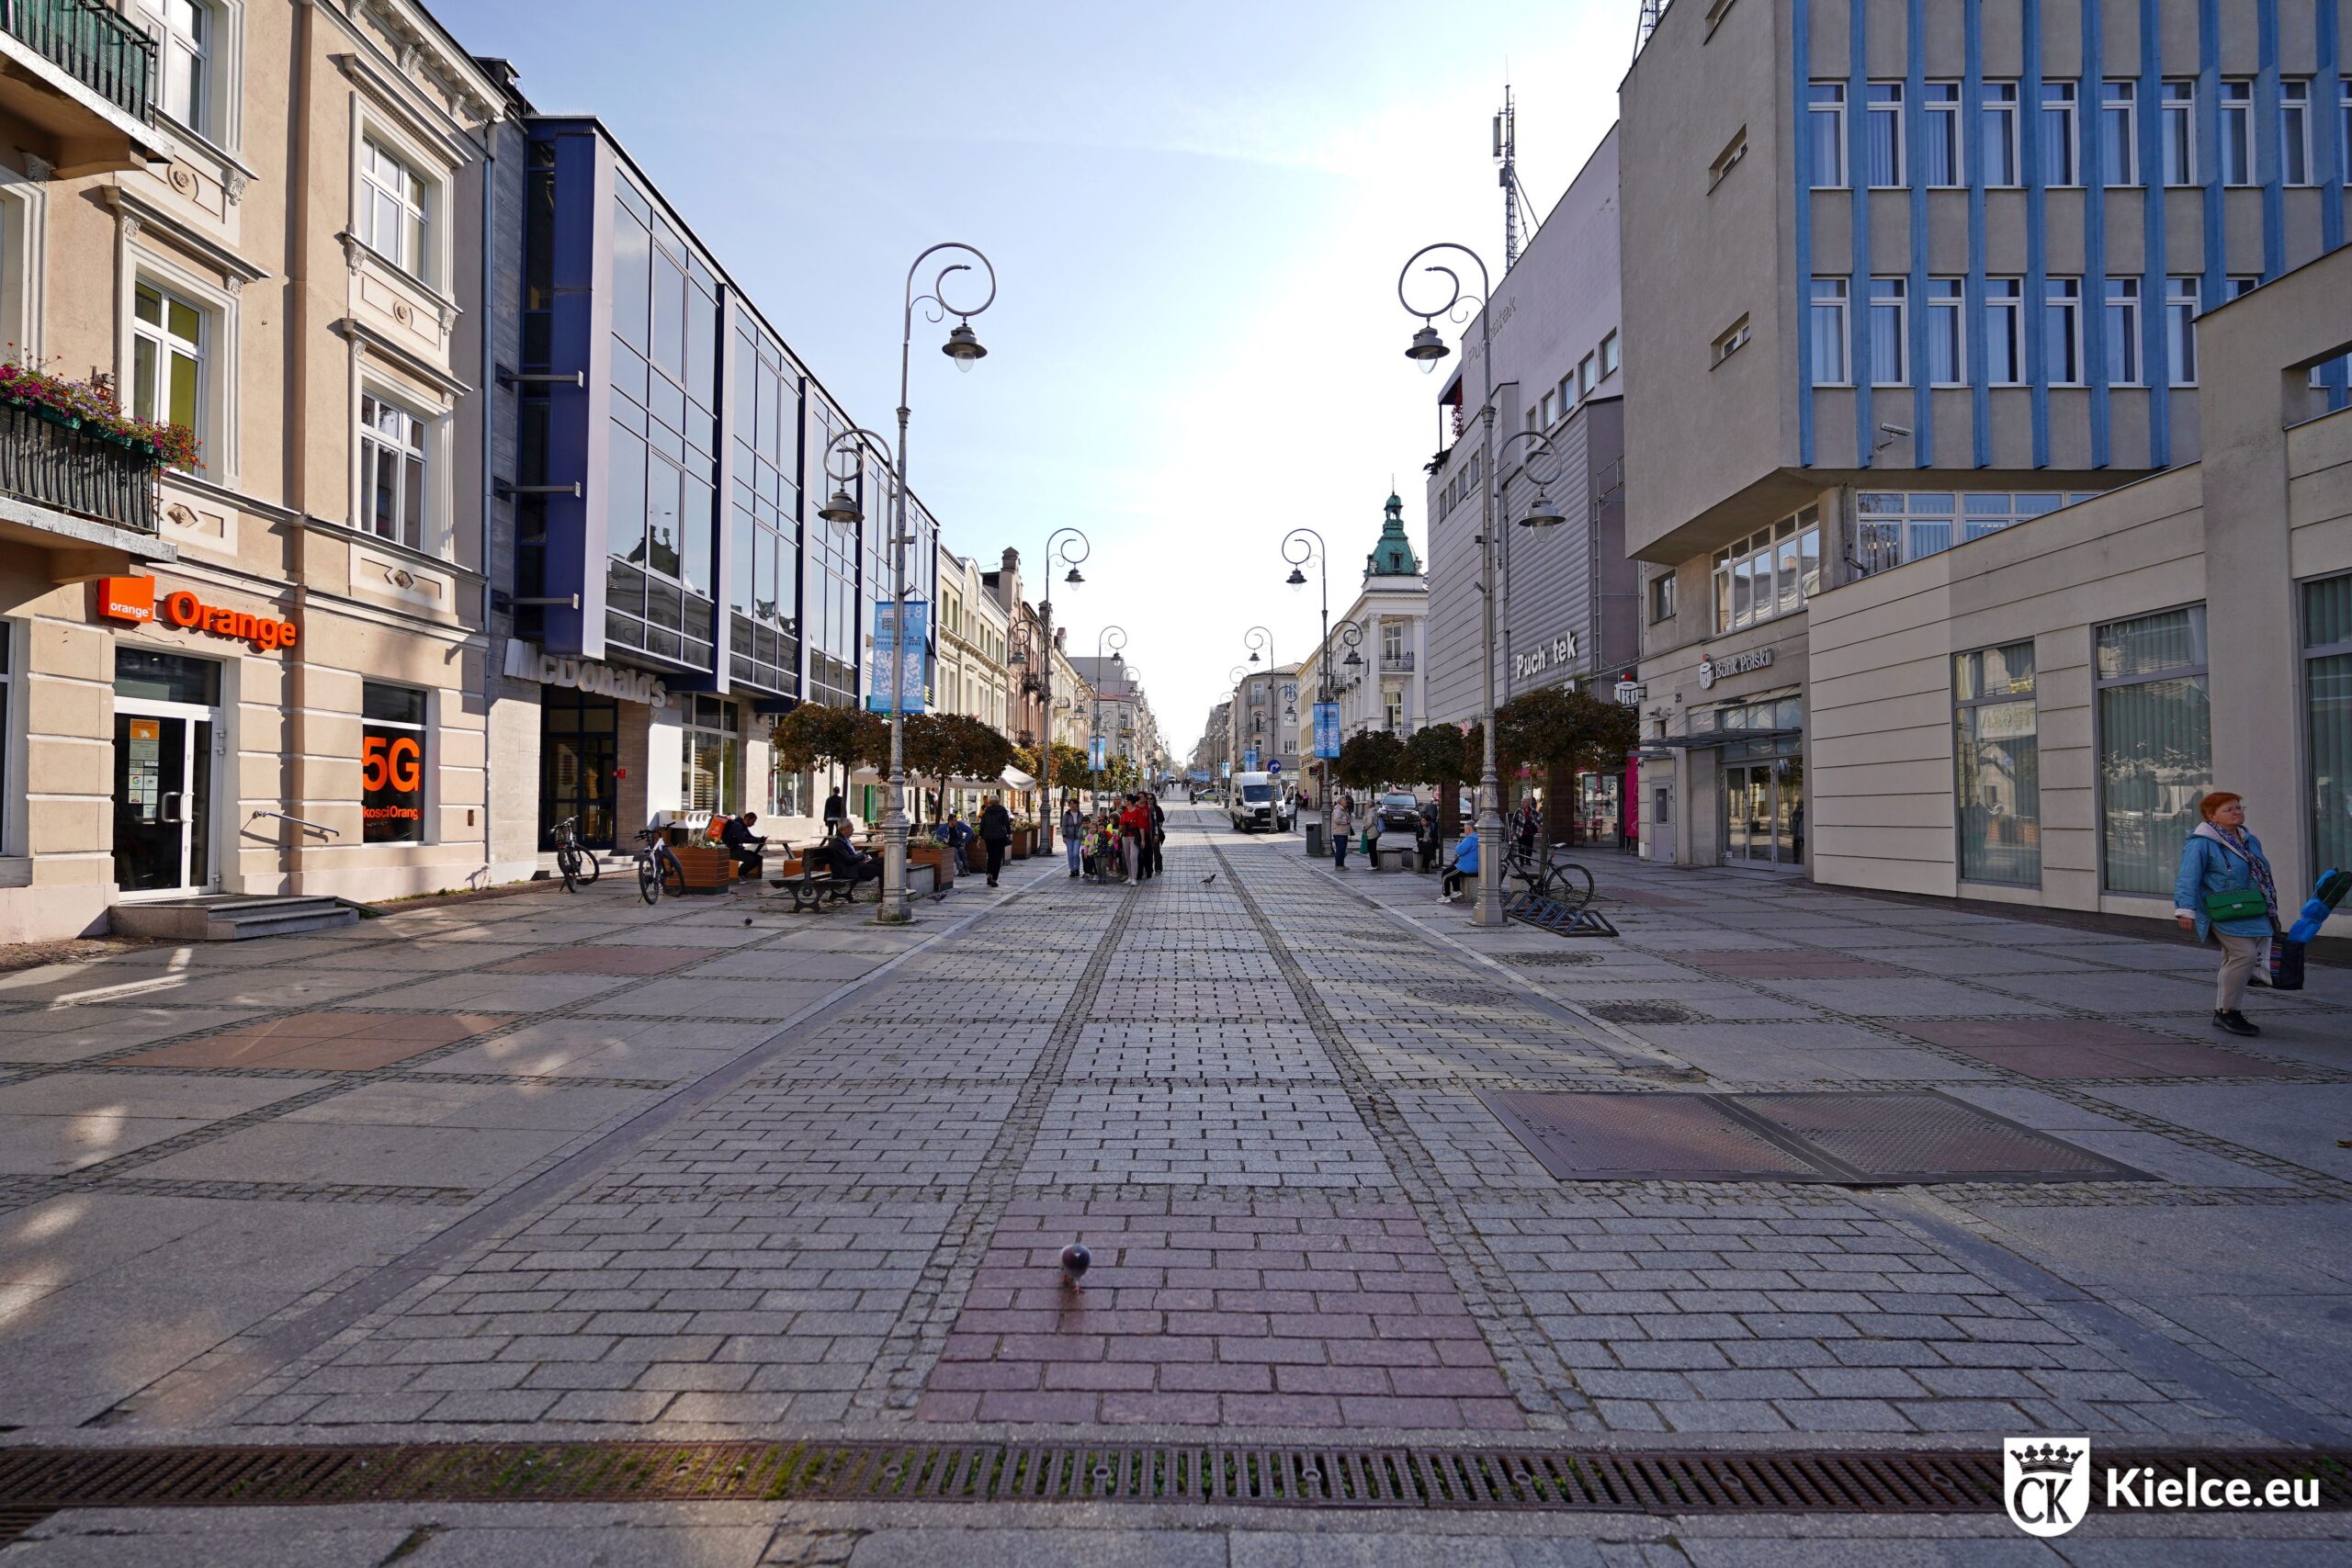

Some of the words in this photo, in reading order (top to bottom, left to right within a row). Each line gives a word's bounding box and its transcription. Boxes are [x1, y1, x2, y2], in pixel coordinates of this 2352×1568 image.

[109, 602, 150, 618] orange
[166, 591, 297, 650] Orange
[1516, 645, 1547, 680] Puch
[1553, 631, 1577, 664] tek
[1715, 657, 1738, 679] Bank
[1740, 648, 1770, 672] Polski
[363, 736, 421, 793] 5G
